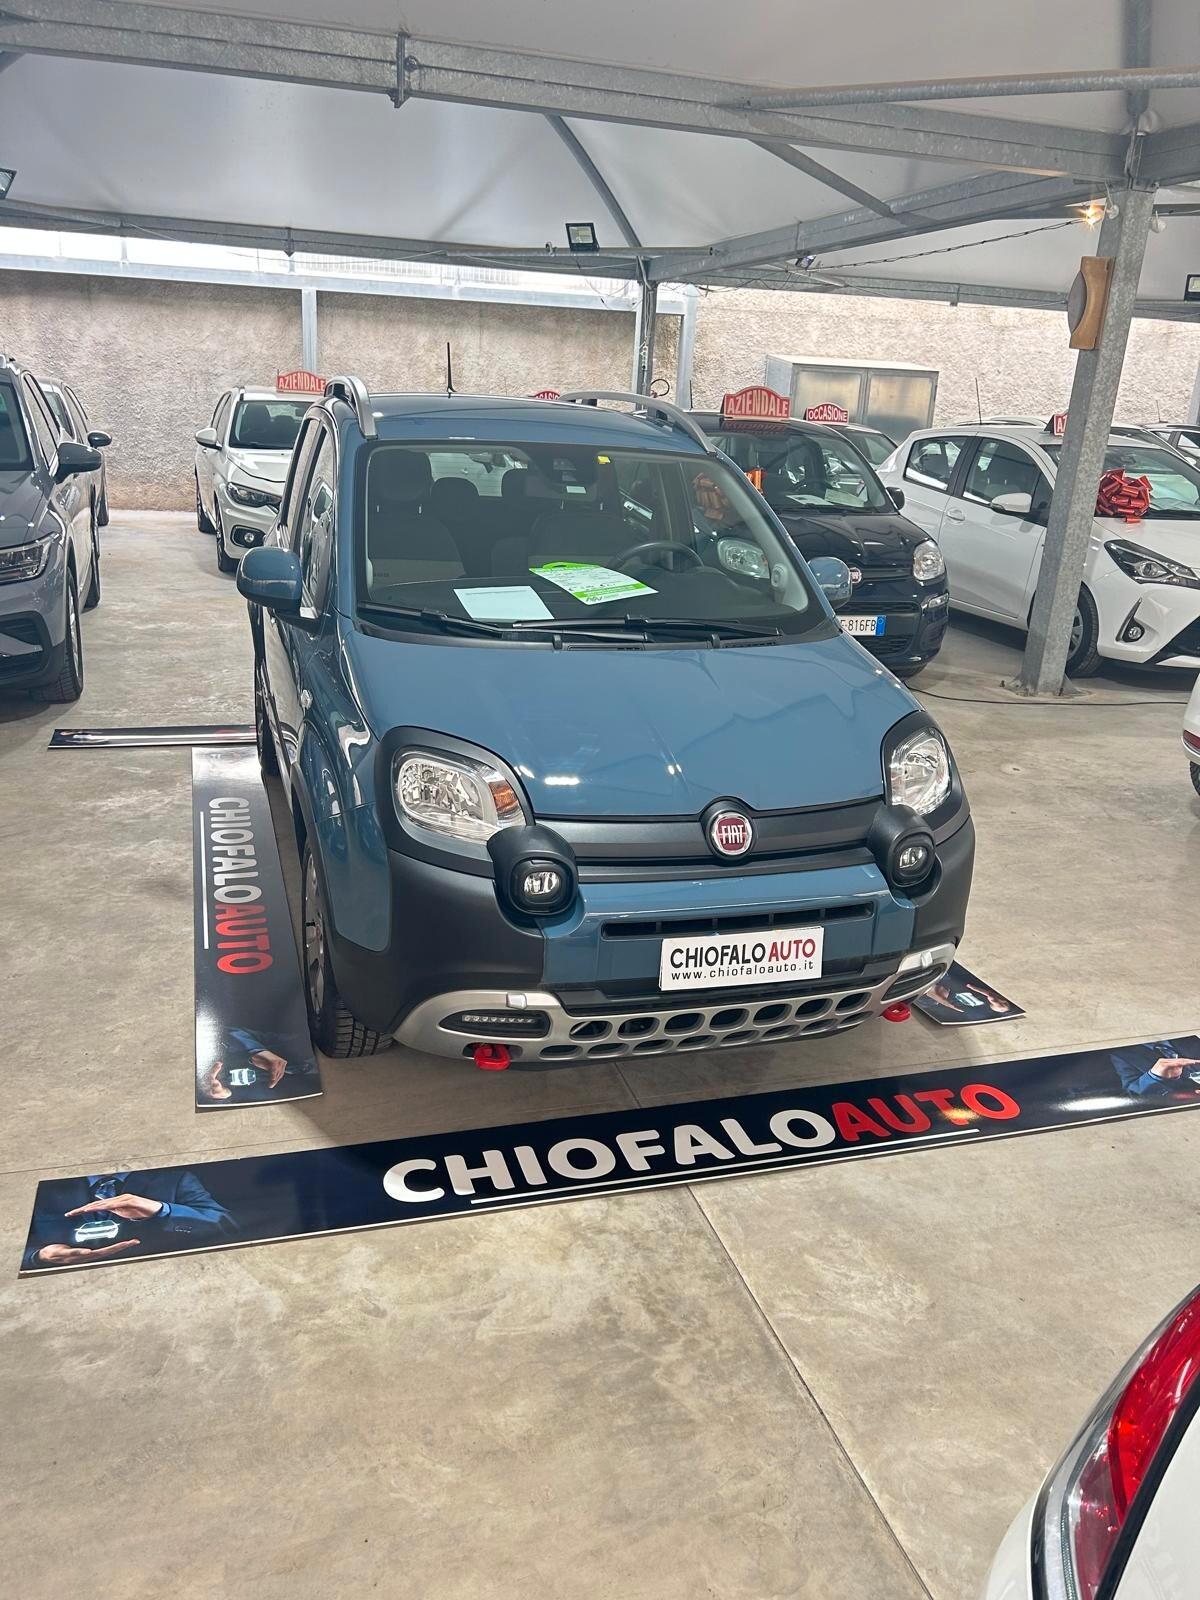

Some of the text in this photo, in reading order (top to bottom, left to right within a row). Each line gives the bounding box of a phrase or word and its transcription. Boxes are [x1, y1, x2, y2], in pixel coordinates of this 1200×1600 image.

[278, 372, 325, 391] AZIENDALE
[727, 389, 789, 417] AZIENDALE
[808, 405, 848, 422] OCCASIONE
[721, 824, 744, 845] FIAT
[671, 959, 815, 980] www.chiofaloauto.it
